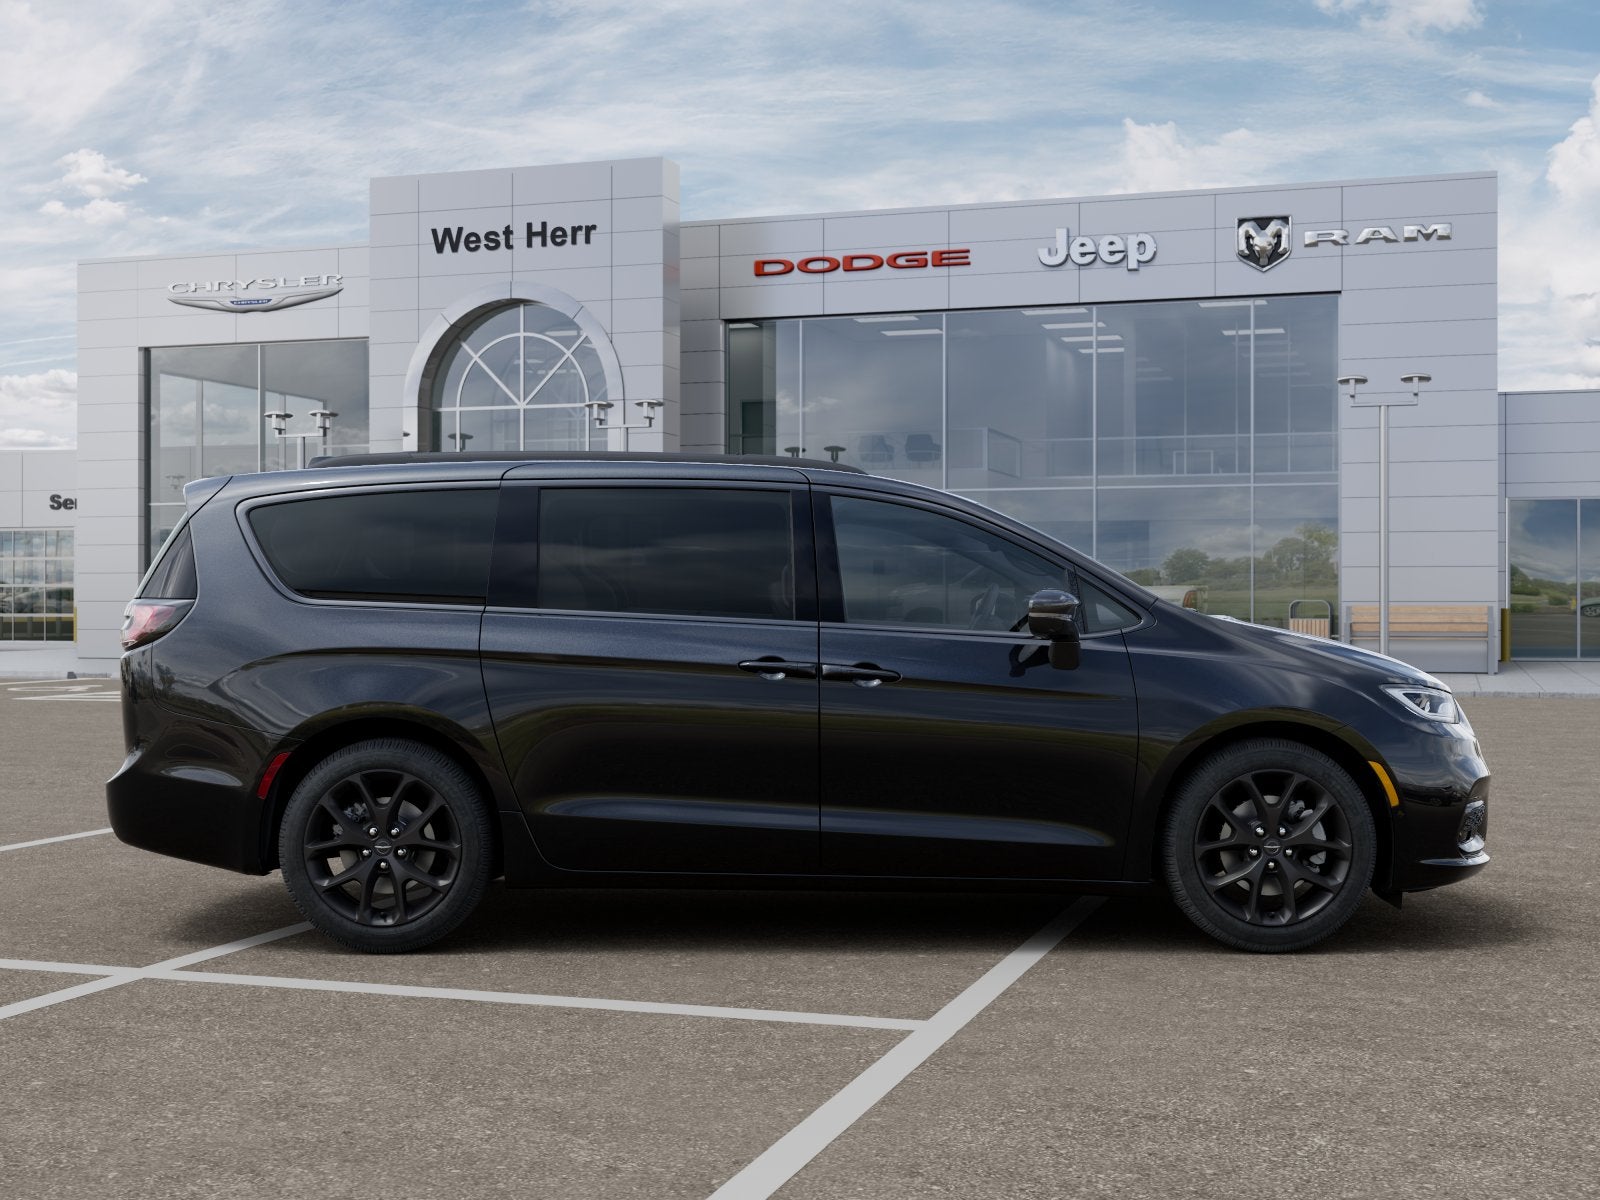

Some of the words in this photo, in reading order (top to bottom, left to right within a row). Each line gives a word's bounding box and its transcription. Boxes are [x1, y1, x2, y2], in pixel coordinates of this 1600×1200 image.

[431, 225, 514, 254] West
[526, 221, 597, 248] Herr
[1037, 227, 1157, 271] Jeep
[1304, 223, 1452, 248] RAM
[754, 249, 971, 276] DODGE
[168, 273, 343, 294] CHRYSLER
